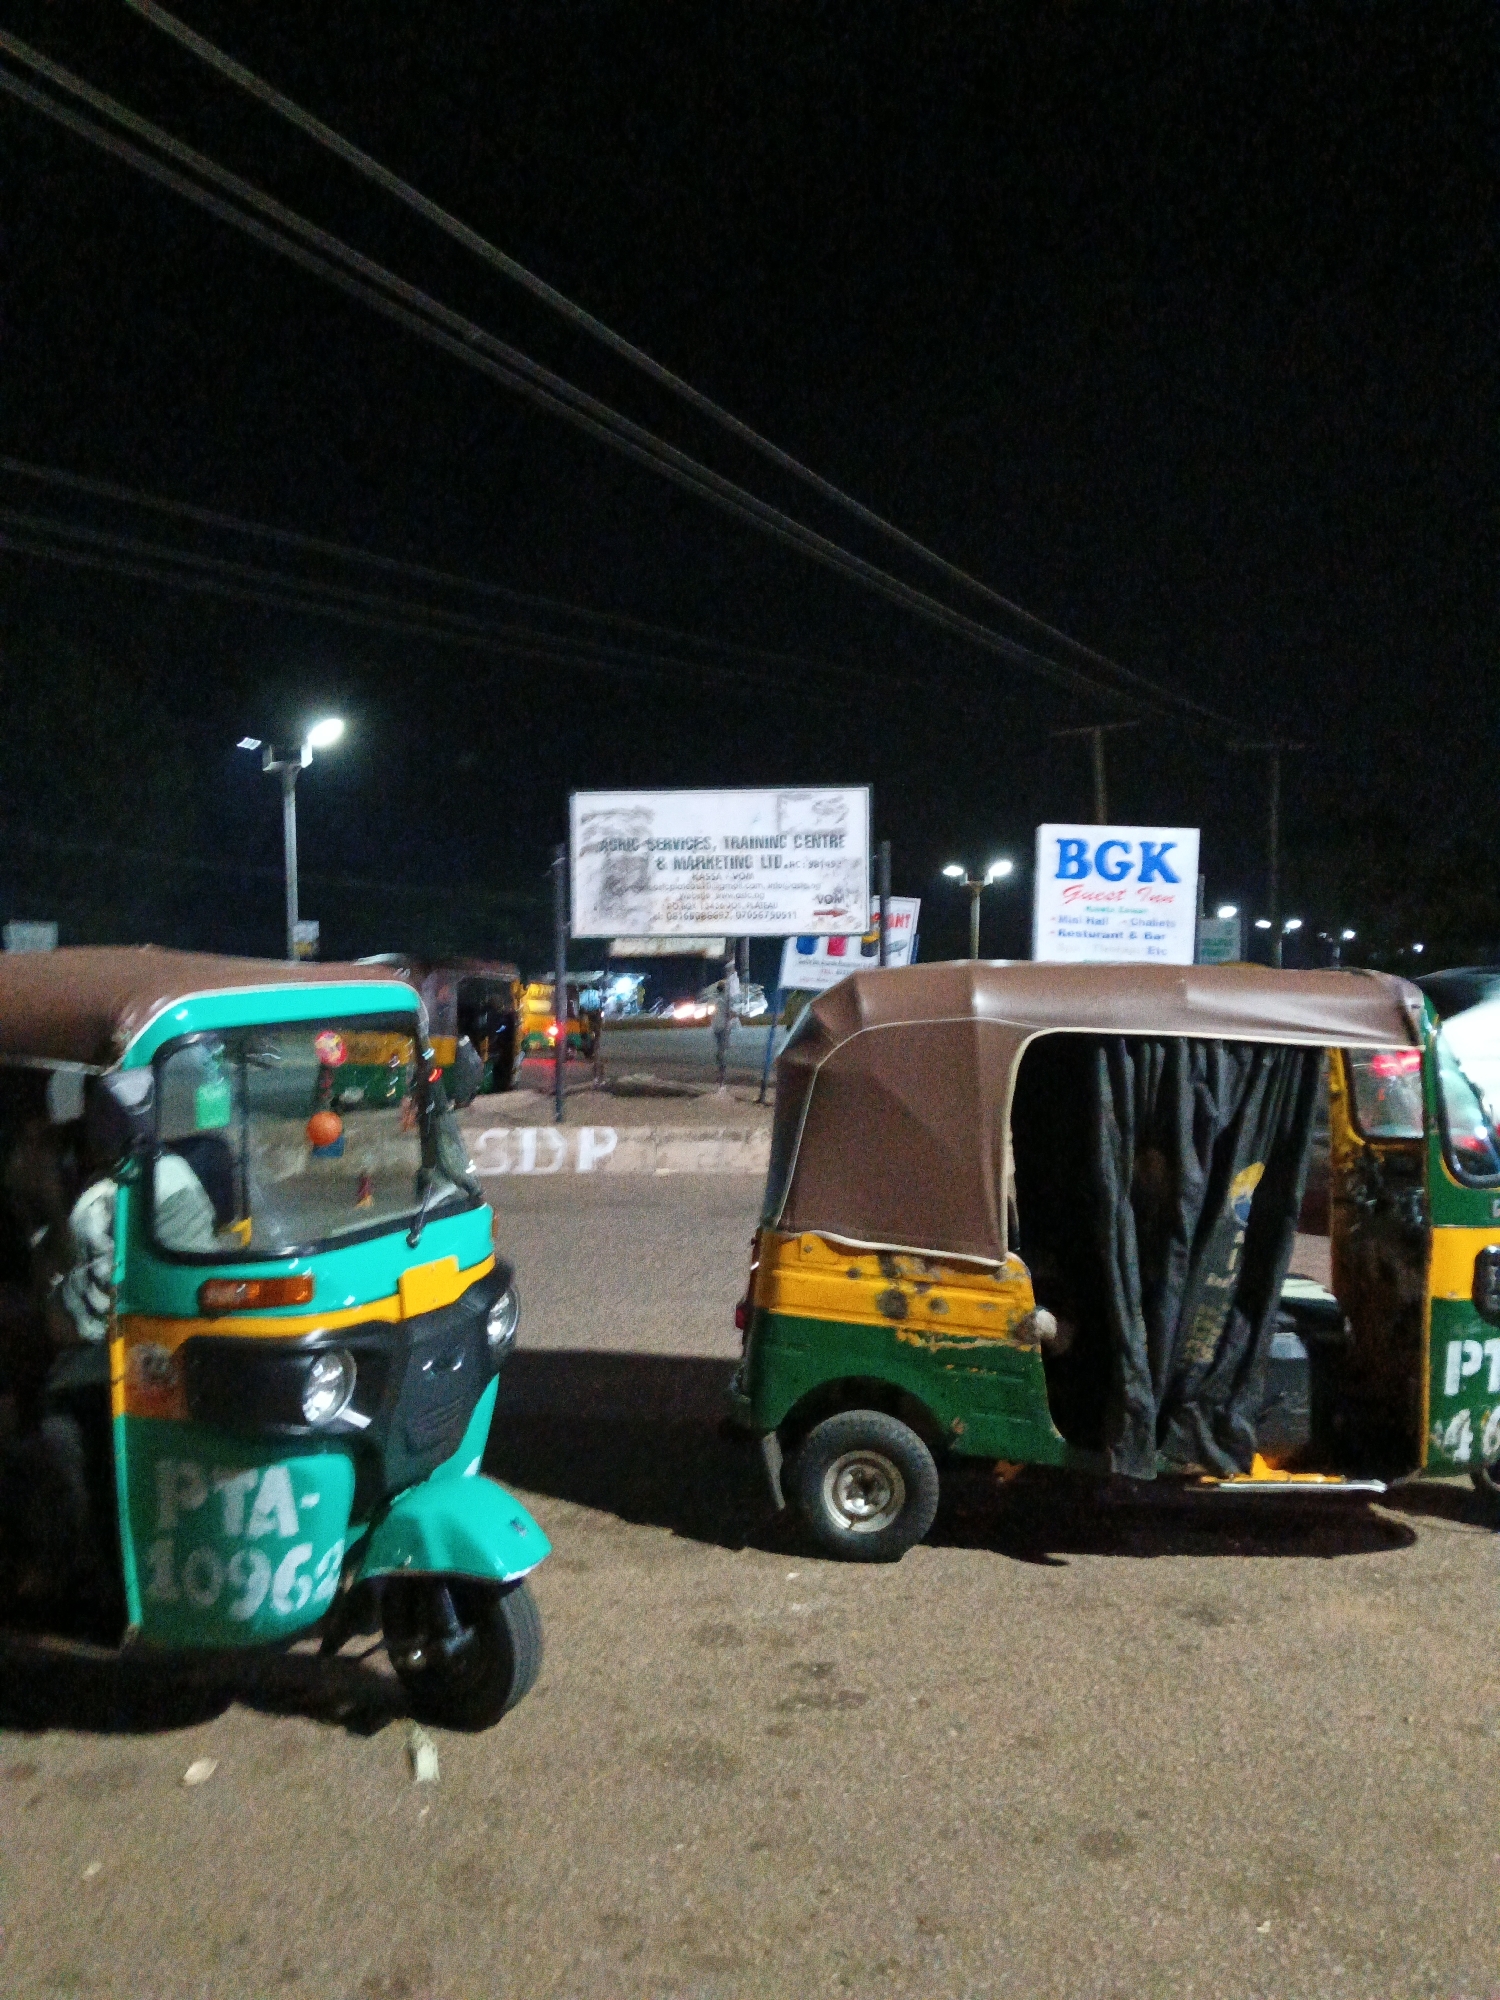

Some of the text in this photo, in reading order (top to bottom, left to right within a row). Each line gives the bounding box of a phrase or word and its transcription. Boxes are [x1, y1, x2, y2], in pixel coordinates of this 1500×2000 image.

[647, 835, 717, 852] SERVICES,
[723, 834, 787, 850] TRAINING
[793, 832, 845, 849] CENTRE
[656, 855, 667, 870] &
[673, 854, 754, 870] MARKETING
[1055, 838, 1181, 883] BGK
[1060, 884, 1176, 905] Guest Inn
[1144, 932, 1166, 940] Bar
